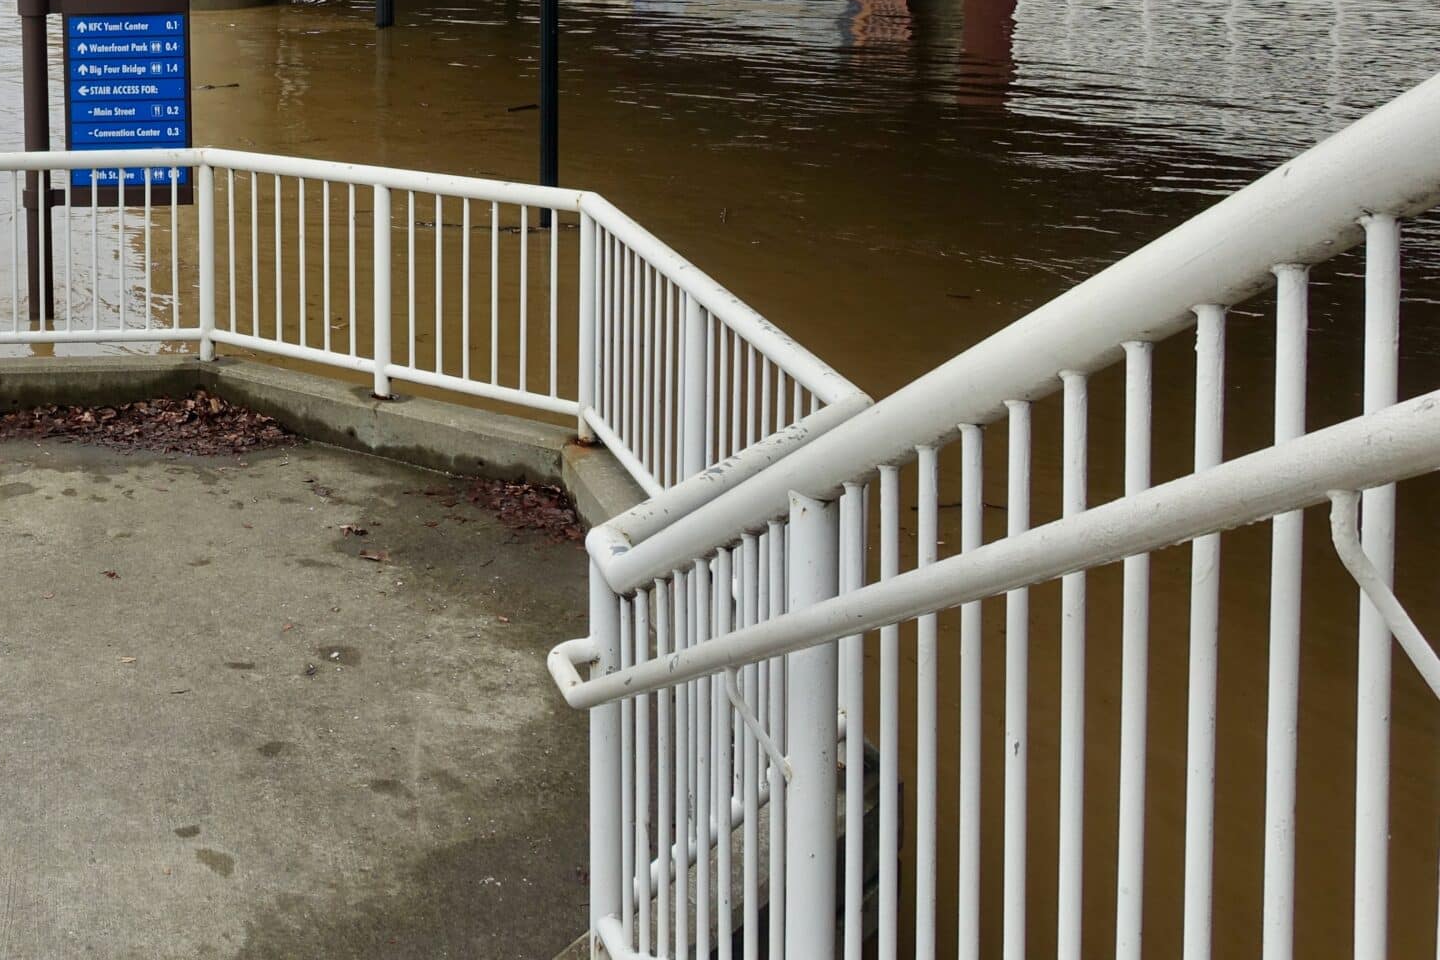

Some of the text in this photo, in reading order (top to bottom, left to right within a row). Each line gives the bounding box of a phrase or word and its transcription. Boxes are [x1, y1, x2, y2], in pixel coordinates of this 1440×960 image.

[88, 22, 103, 32] KFC
[124, 21, 149, 31] Center
[166, 21, 178, 30] 0.1
[88, 42, 178, 53] Waterfront Park 0.4
[89, 63, 178, 76] Big Four Bridge 1.4
[90, 85, 158, 95] STAIR ACCESS FOR:
[114, 107, 136, 116] Street
[166, 106, 179, 115] 0.2
[136, 128, 161, 137] Center
[167, 127, 179, 136] 0.3
